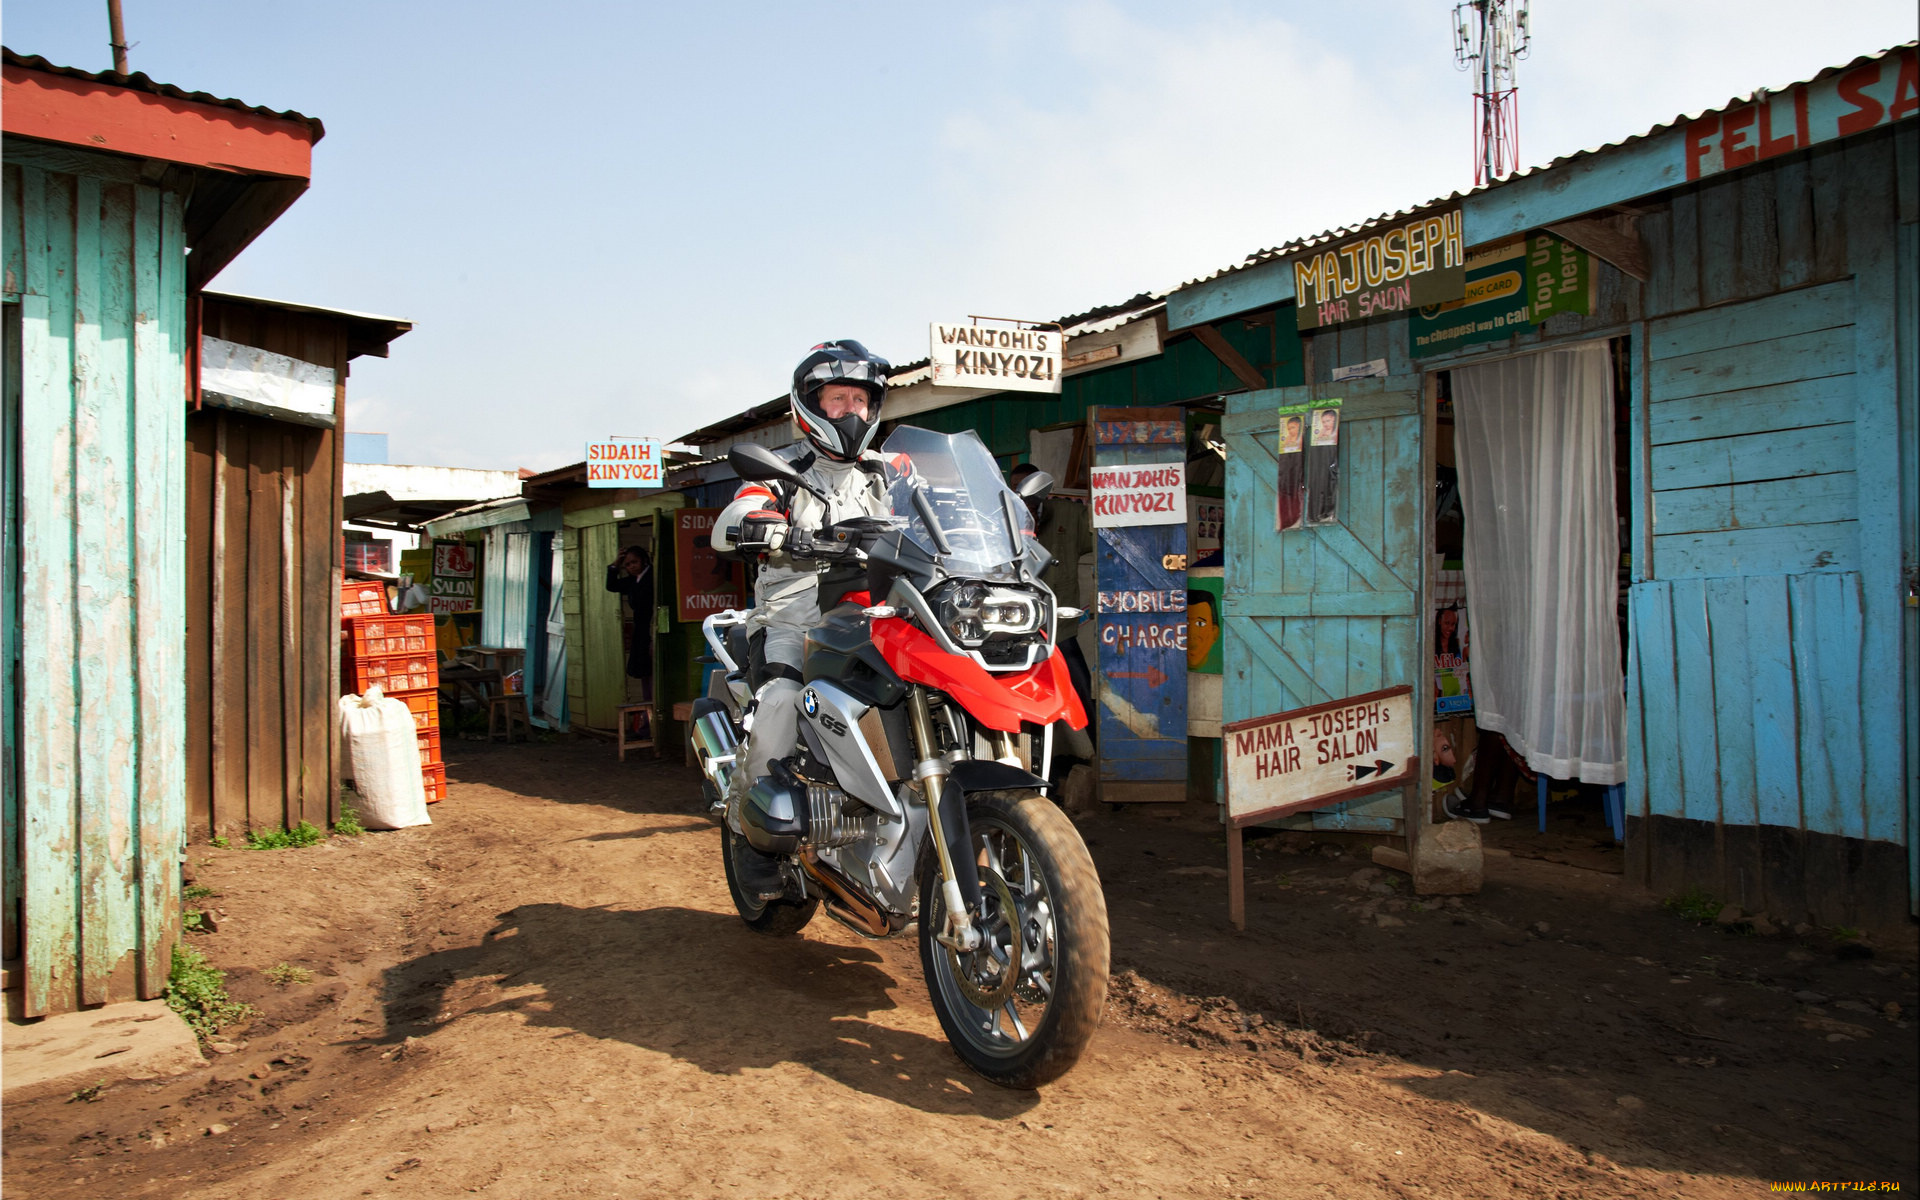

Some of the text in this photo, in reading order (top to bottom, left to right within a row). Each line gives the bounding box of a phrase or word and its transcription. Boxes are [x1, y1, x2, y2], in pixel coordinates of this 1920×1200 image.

[1685, 84, 1810, 182] FELI
[1294, 209, 1463, 308] MAJOSEPH
[1557, 240, 1579, 295] here
[1486, 278, 1513, 293] CARD
[1531, 234, 1556, 316] Top Up
[1318, 280, 1411, 327] HAIR SALON
[938, 325, 1048, 351] WANJOHI'S
[1416, 335, 1430, 346] The
[1430, 321, 1476, 342] cheapest
[1477, 322, 1494, 333] way
[1494, 315, 1505, 327] to
[955, 349, 1054, 382] KINYOZI
[589, 444, 651, 460] SIDAIH
[588, 464, 659, 480] KINYOZI
[1094, 492, 1176, 516] KINYOZI
[681, 515, 719, 529] SIDA
[432, 578, 475, 596] SALON
[686, 594, 738, 609] KINYOZI
[1097, 590, 1187, 613] MOBILE
[1101, 622, 1188, 651] CHARGE
[820, 713, 848, 737] GS
[1235, 722, 1294, 757] MAMA
[1256, 728, 1378, 780] HAIR SALON
